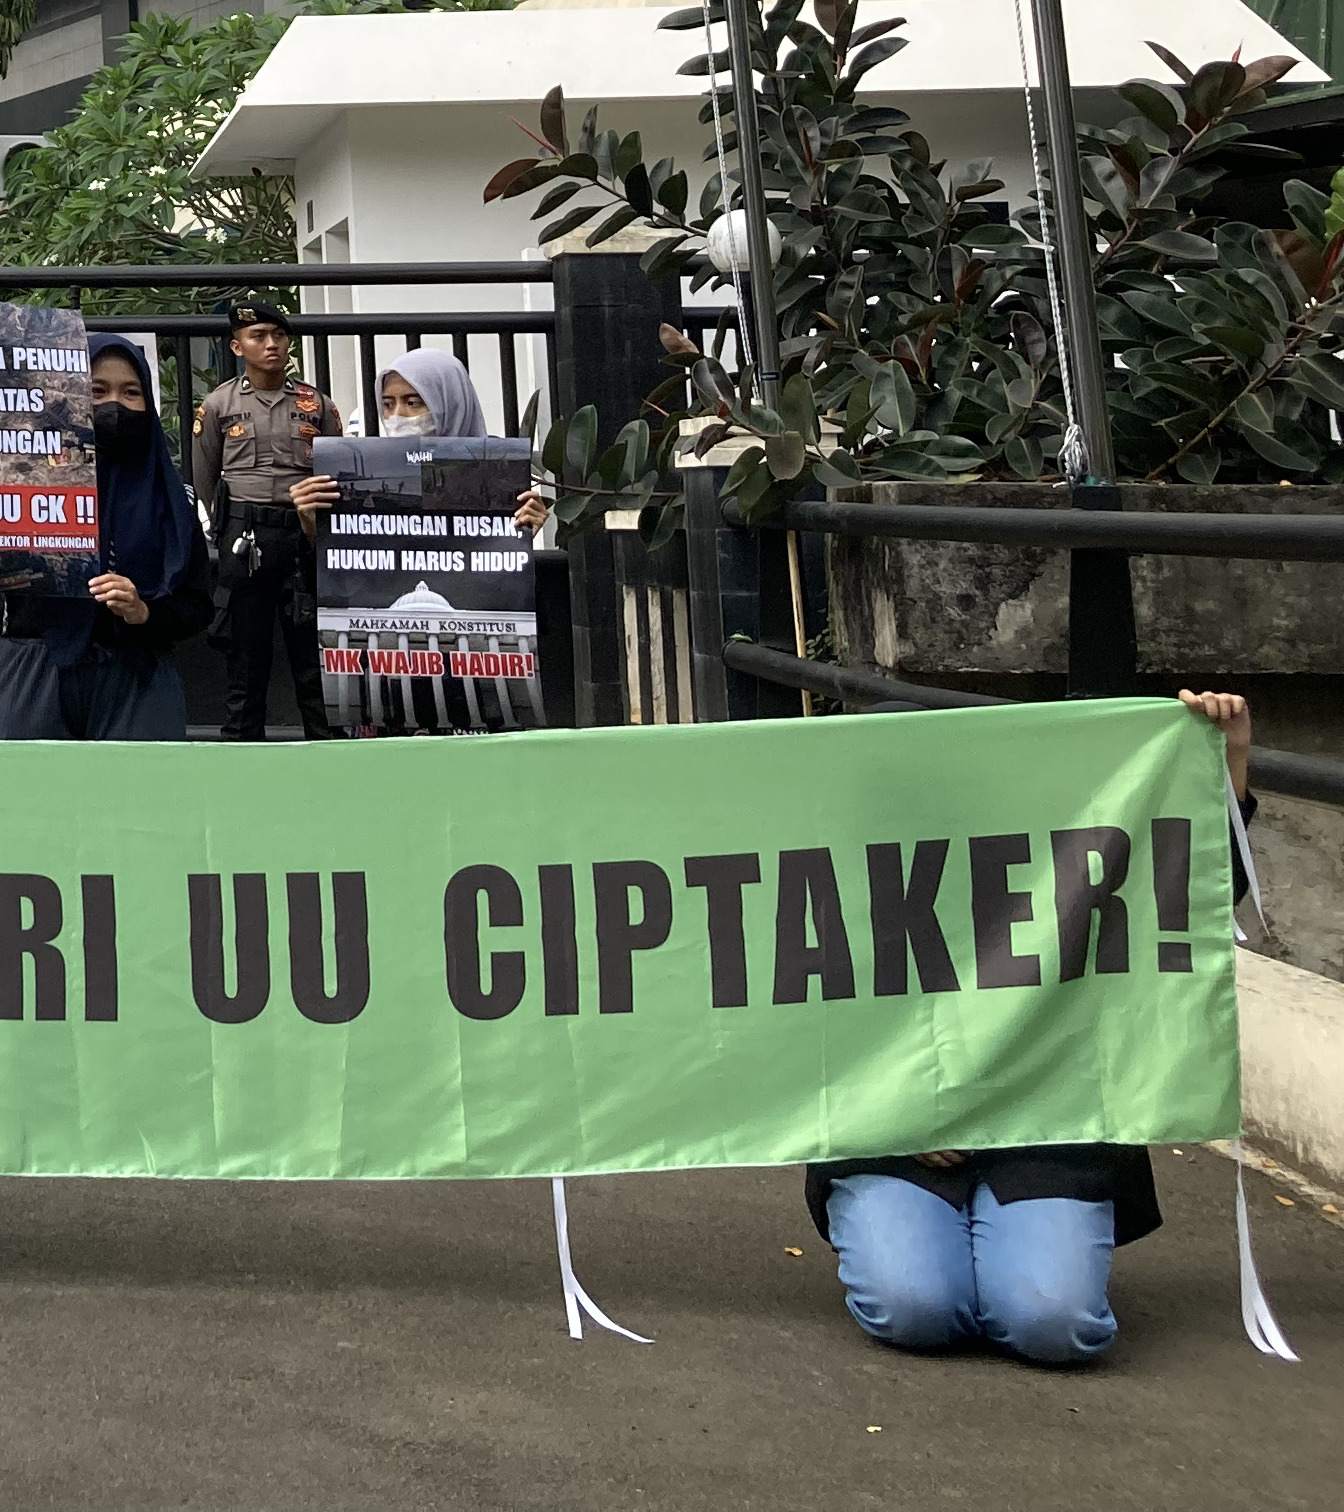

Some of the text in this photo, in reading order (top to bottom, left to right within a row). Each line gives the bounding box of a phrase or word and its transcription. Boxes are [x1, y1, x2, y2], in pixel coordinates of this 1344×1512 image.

[12, 346, 88, 373] PENUHI
[30, 494, 68, 524] CK
[76, 495, 95, 524] !!
[330, 513, 523, 539] LINGKUNGAN RUSAK,
[33, 535, 95, 549] LINGKUNGAN
[327, 548, 529, 572] HUKUM HARUS HIDUP
[349, 619, 517, 633] MAHKAMAH KONSTITUSI
[323, 648, 535, 679] MK WAJIB HADIR!
[187, 871, 371, 1025] UU
[443, 818, 1193, 1022] CIPTAKER!
